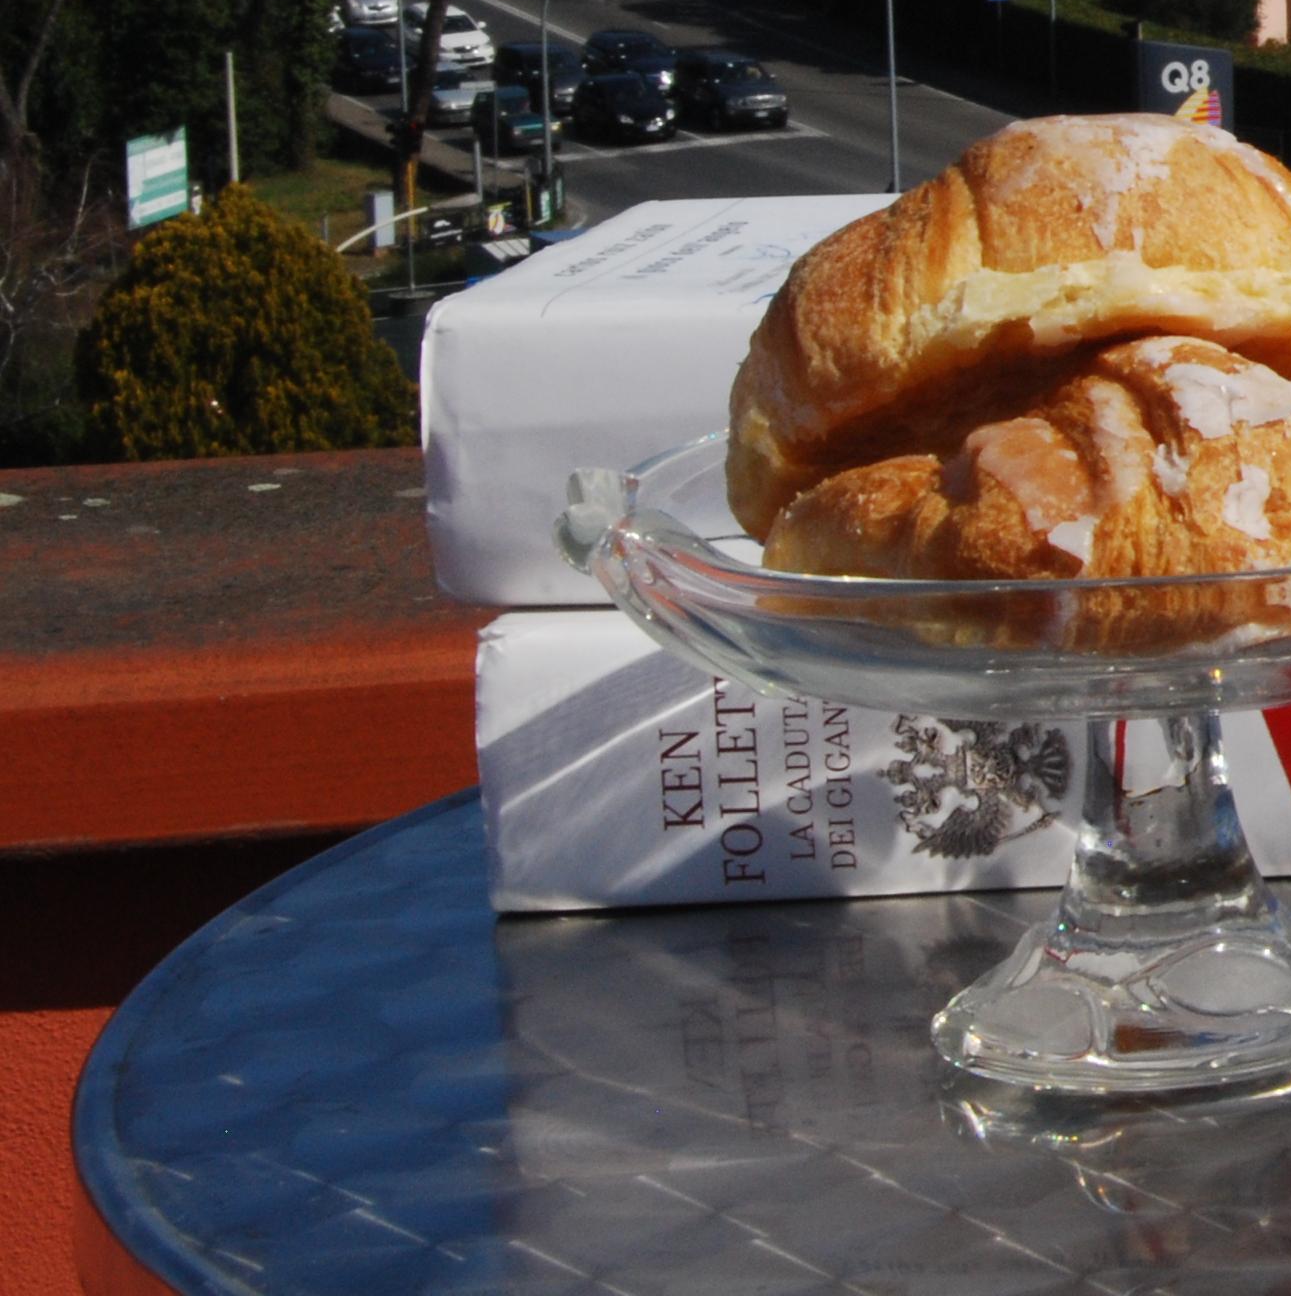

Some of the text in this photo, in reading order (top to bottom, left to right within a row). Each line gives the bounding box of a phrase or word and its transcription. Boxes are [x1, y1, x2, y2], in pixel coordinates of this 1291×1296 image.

[1161, 59, 1211, 93] Q8
[659, 729, 704, 830] KEN
[822, 700, 857, 870] DEI GIGAN
[790, 822, 816, 861] LA
